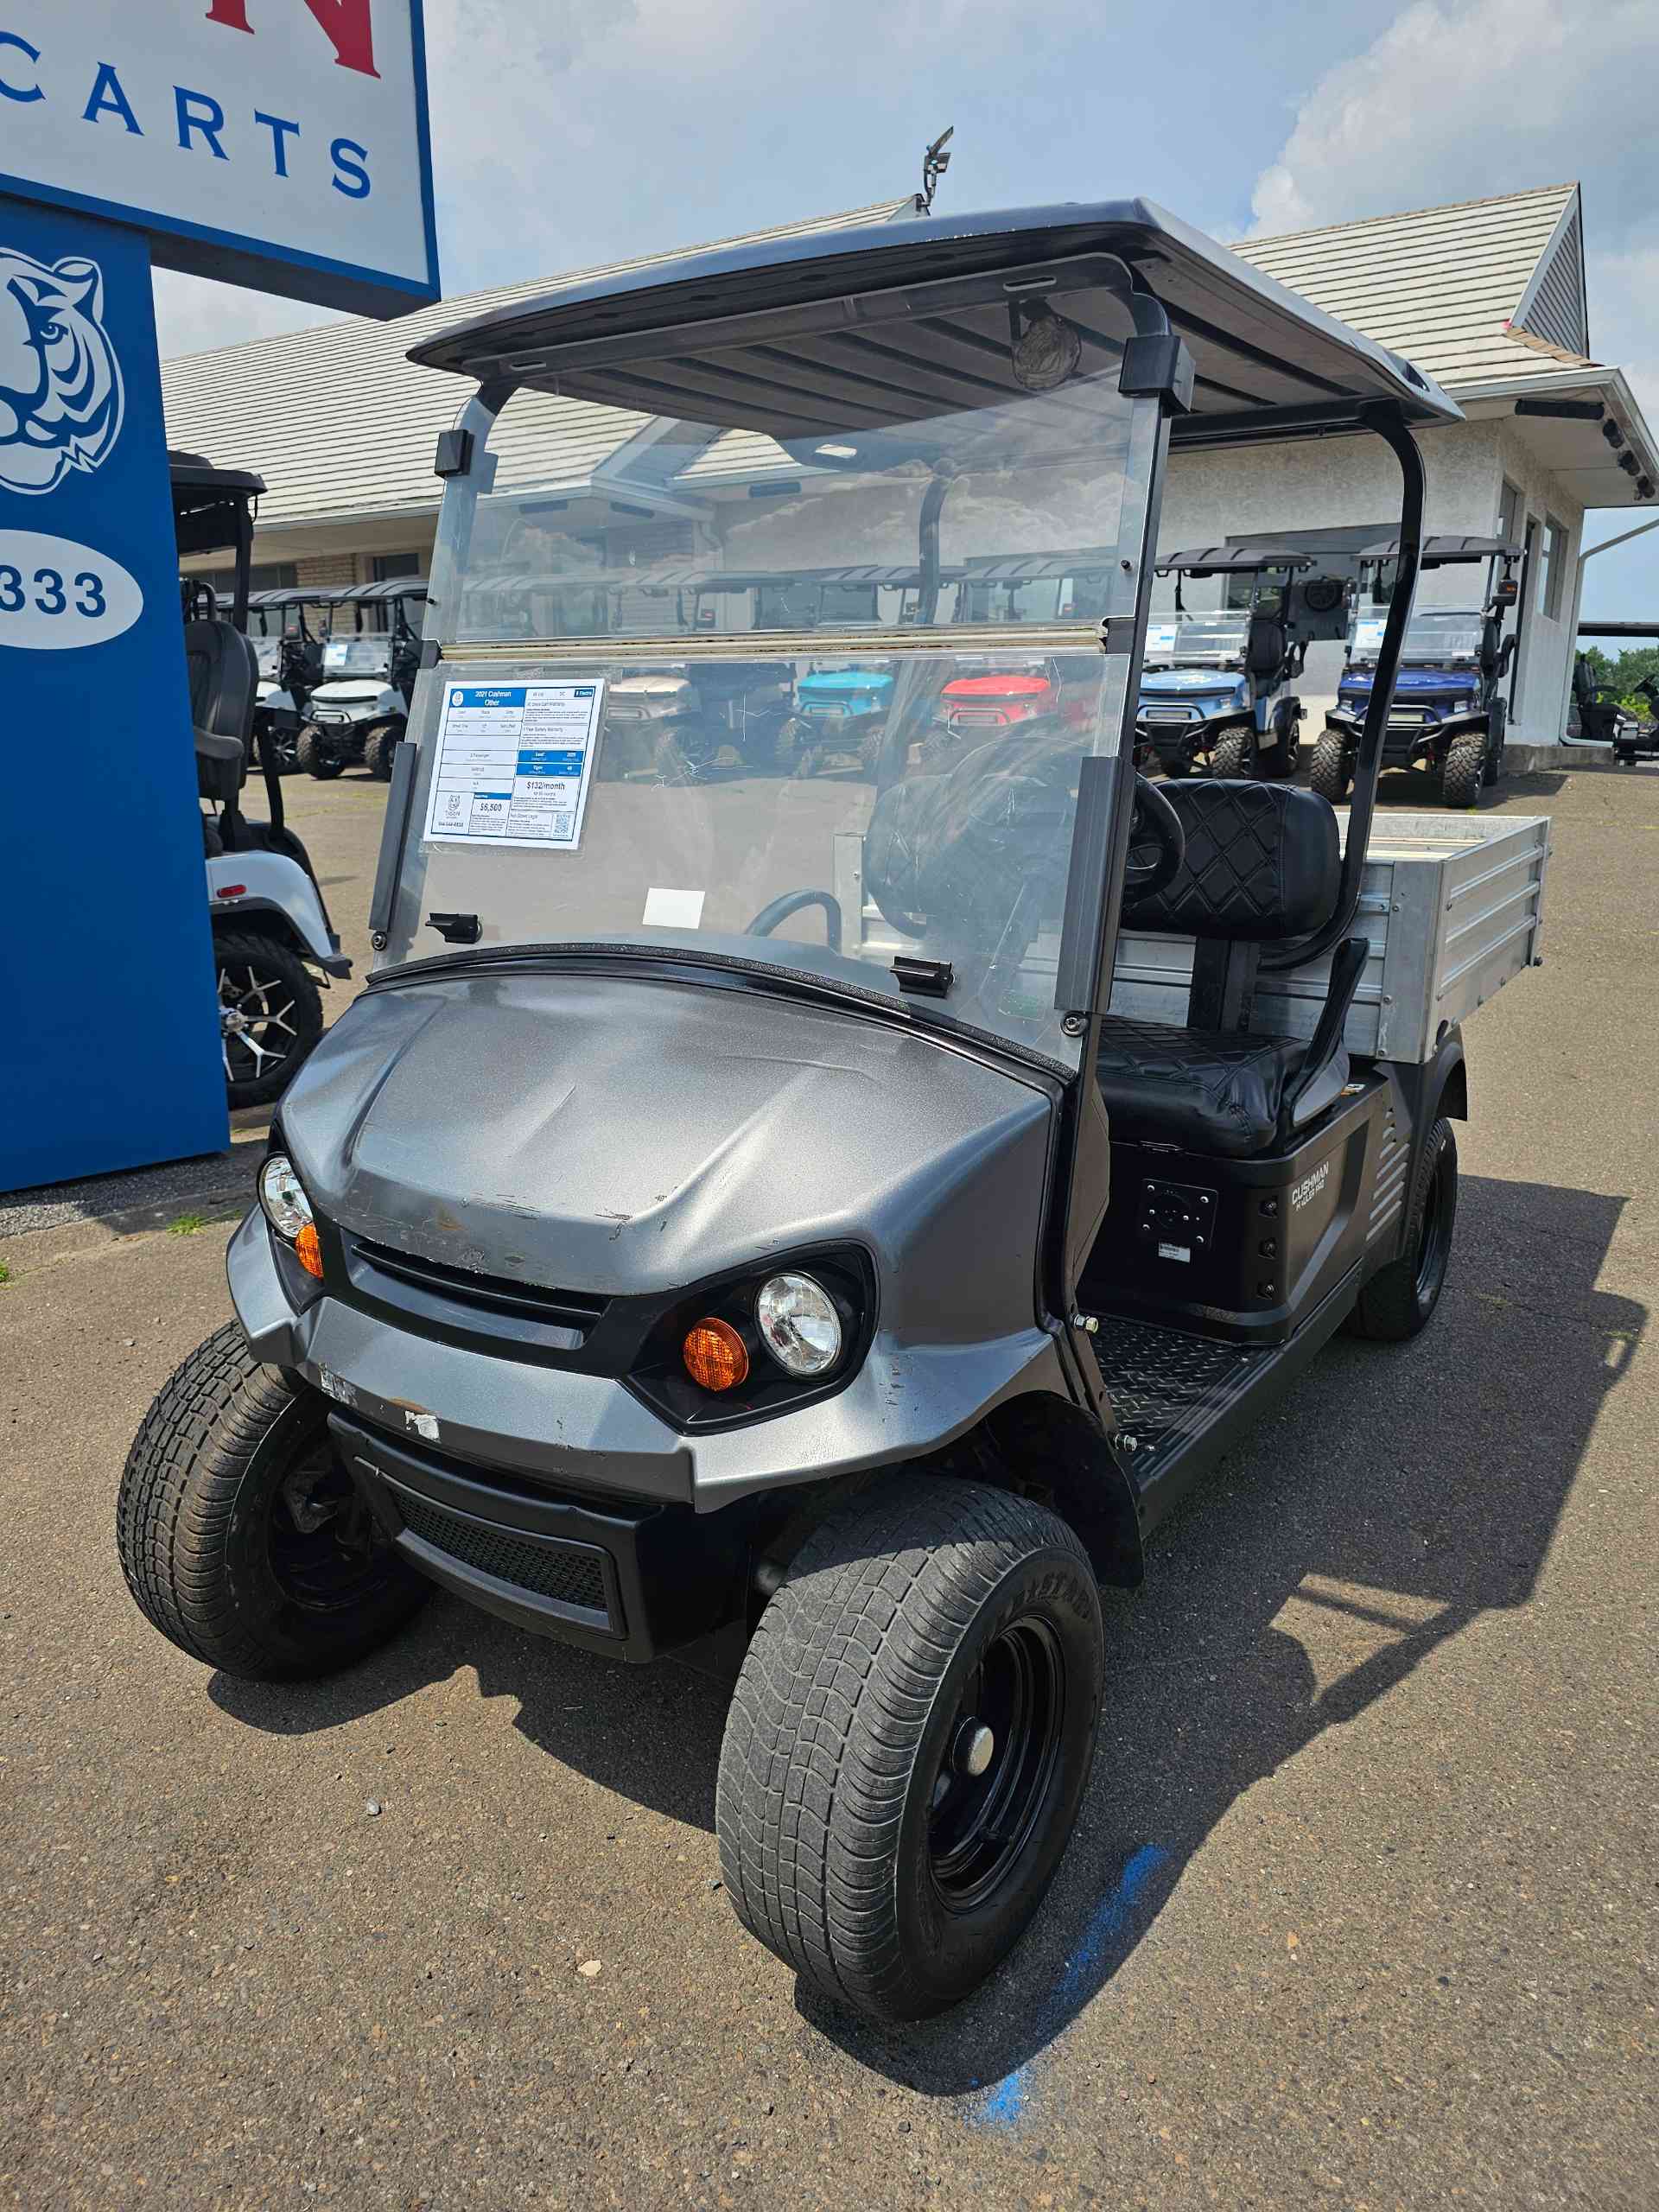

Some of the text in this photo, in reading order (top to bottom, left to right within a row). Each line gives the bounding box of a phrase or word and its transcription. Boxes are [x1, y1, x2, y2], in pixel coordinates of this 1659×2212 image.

[0, 31, 372, 199] CARTS
[0, 564, 106, 618] 333
[1292, 1161, 1329, 1205] CUSHMAN
